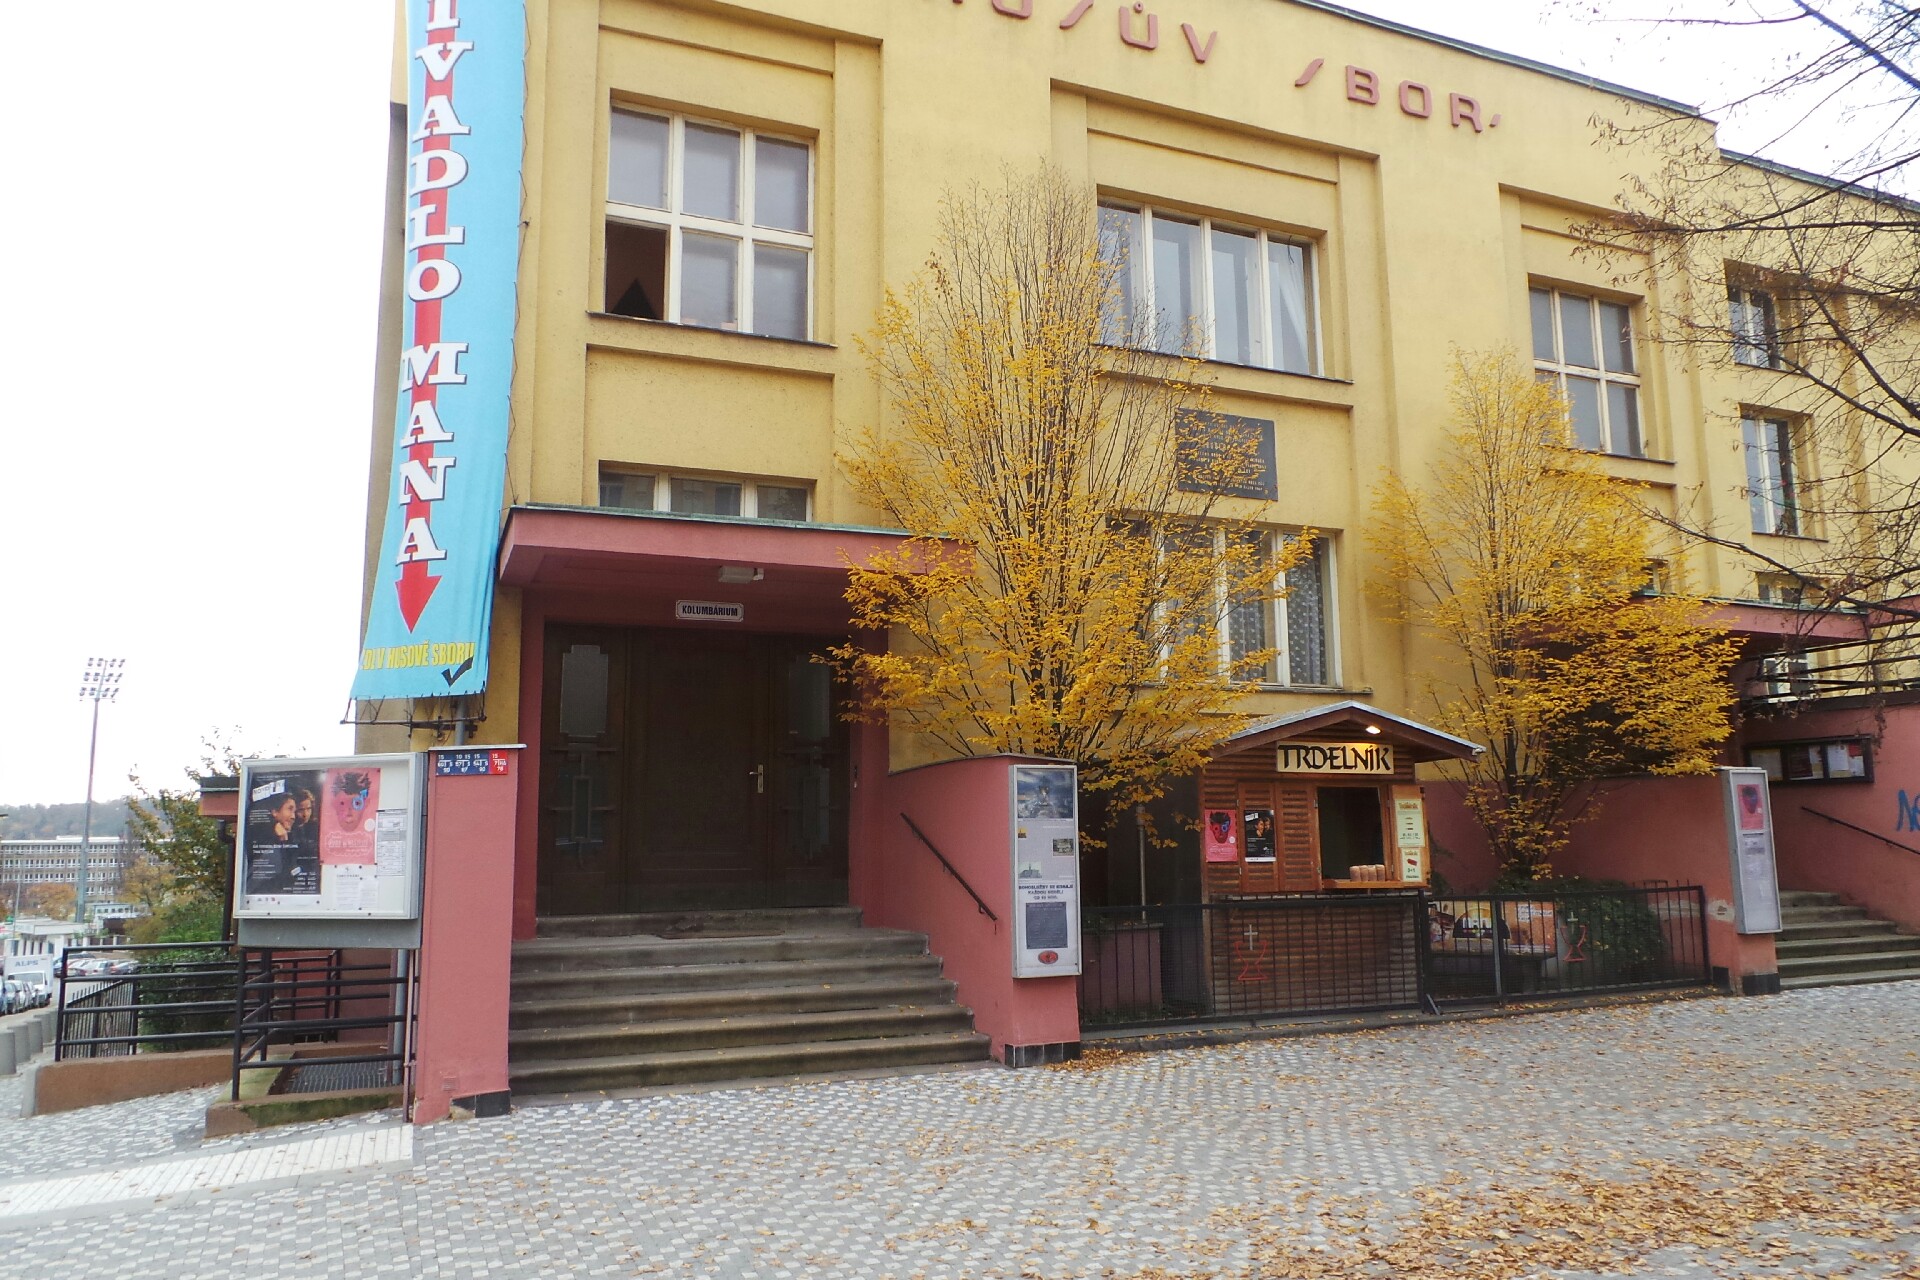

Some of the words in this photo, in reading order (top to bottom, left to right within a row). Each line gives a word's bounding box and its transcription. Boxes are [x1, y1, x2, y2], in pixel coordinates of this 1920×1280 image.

[395, 342, 470, 568] MANA
[682, 605, 738, 616] KOLUMBÁRIUM
[387, 640, 430, 669] HUSOVĚ
[1277, 744, 1392, 772] TRDELNÍK
